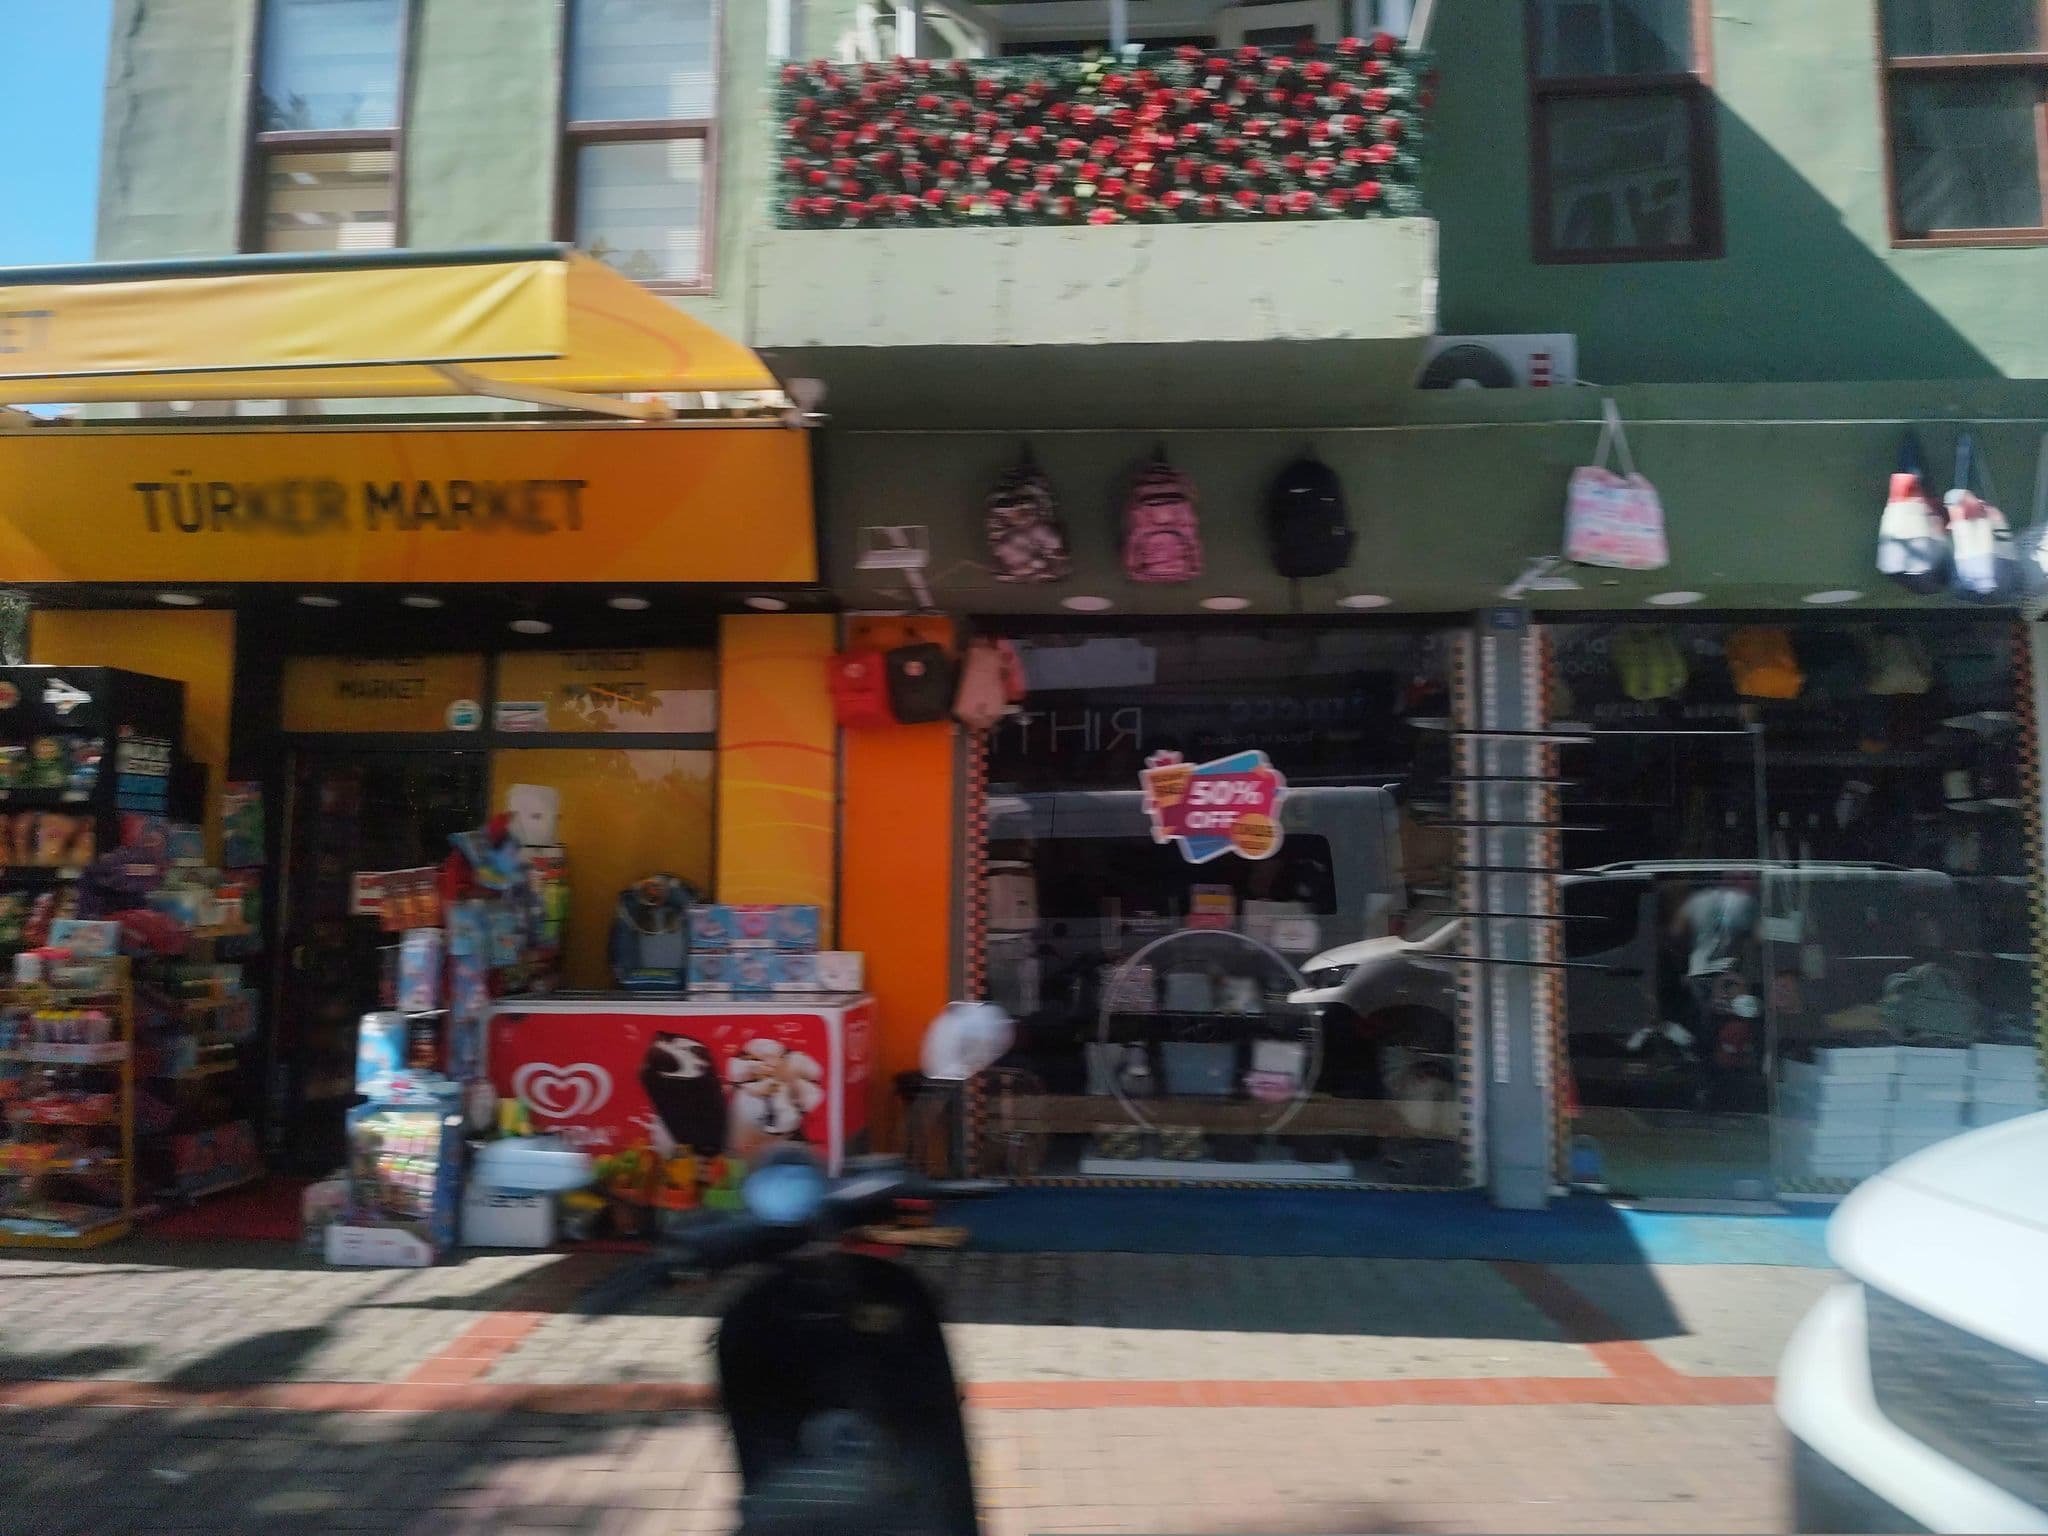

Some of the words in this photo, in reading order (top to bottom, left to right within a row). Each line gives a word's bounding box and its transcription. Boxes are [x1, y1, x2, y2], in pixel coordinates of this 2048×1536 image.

[132, 468, 349, 534] TÜRKER
[364, 478, 589, 534] MARKET
[1187, 780, 1265, 806] 50%
[1185, 811, 1240, 829] OFF
